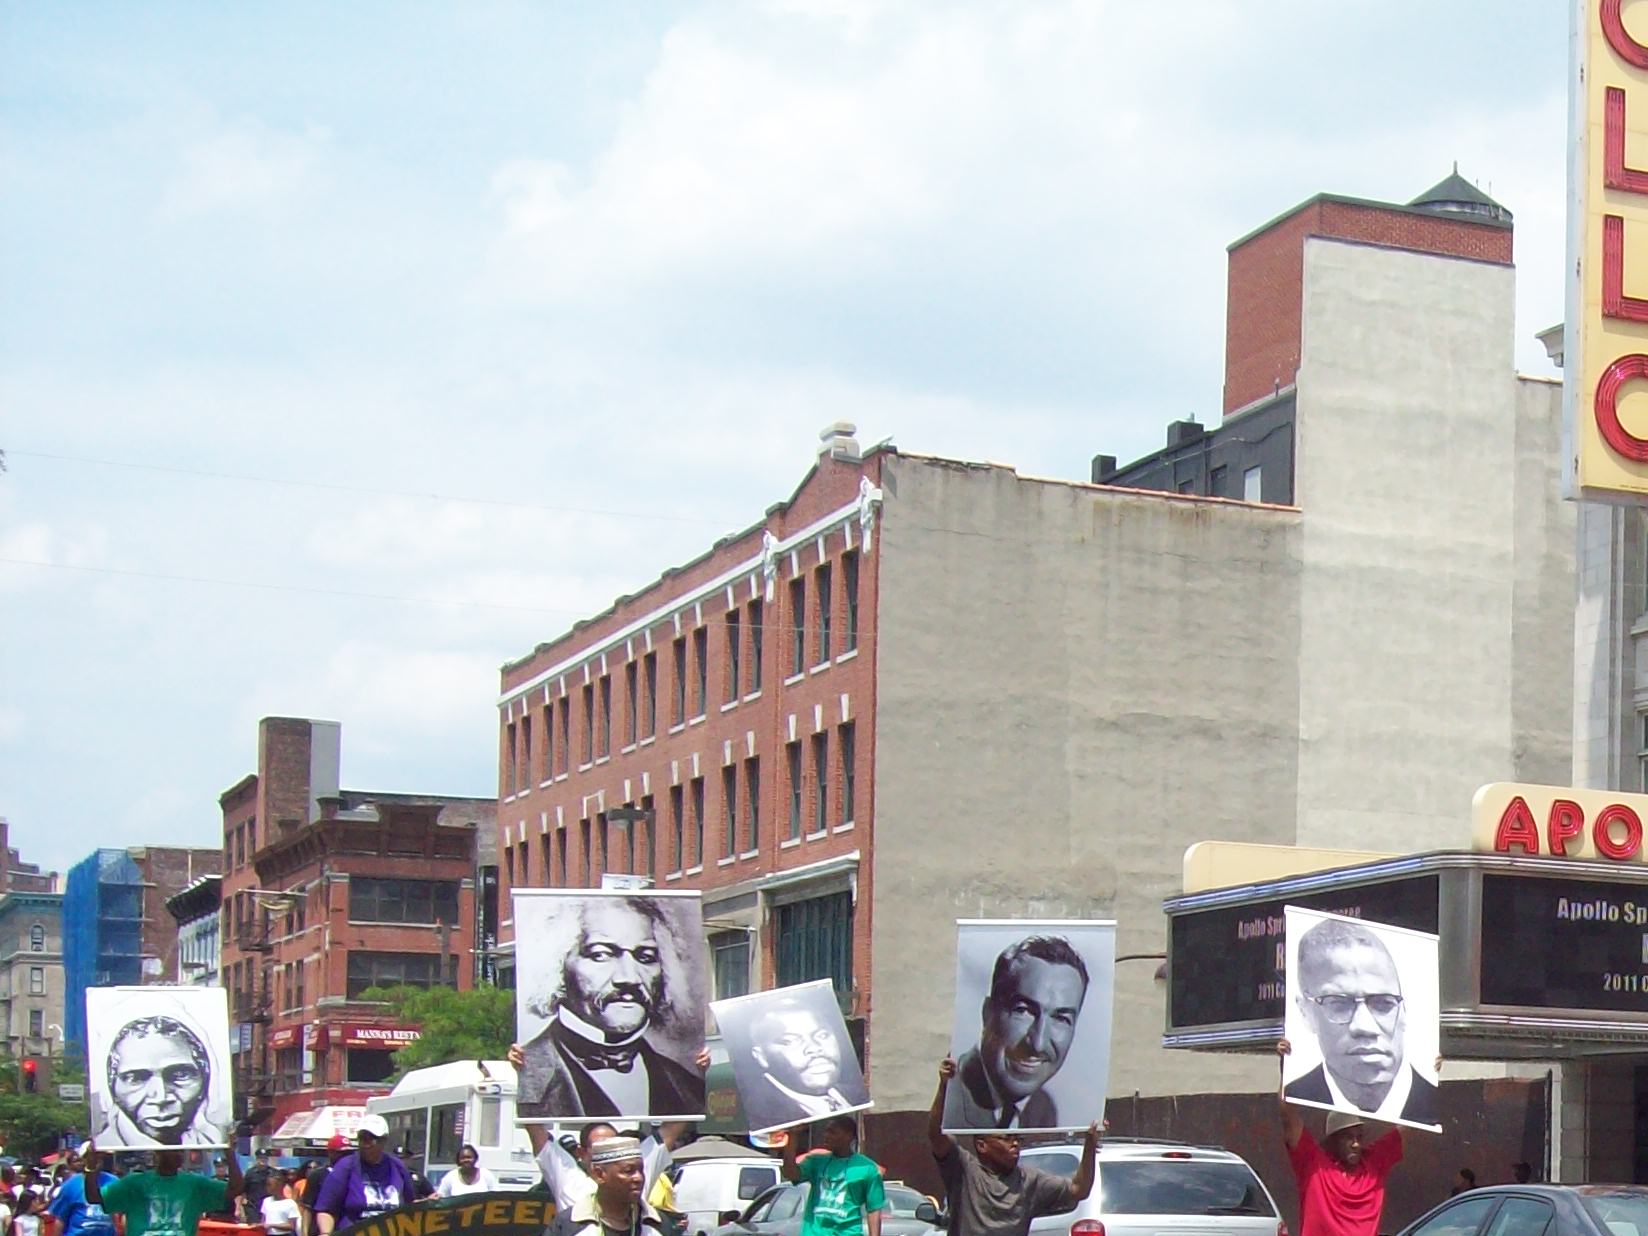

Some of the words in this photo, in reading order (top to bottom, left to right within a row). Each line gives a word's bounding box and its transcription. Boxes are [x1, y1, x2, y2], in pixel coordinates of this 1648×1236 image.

[1557, 897, 1619, 922] Apollo
[1238, 919, 1266, 940] Apollo
[1603, 973, 1637, 992] 2011
